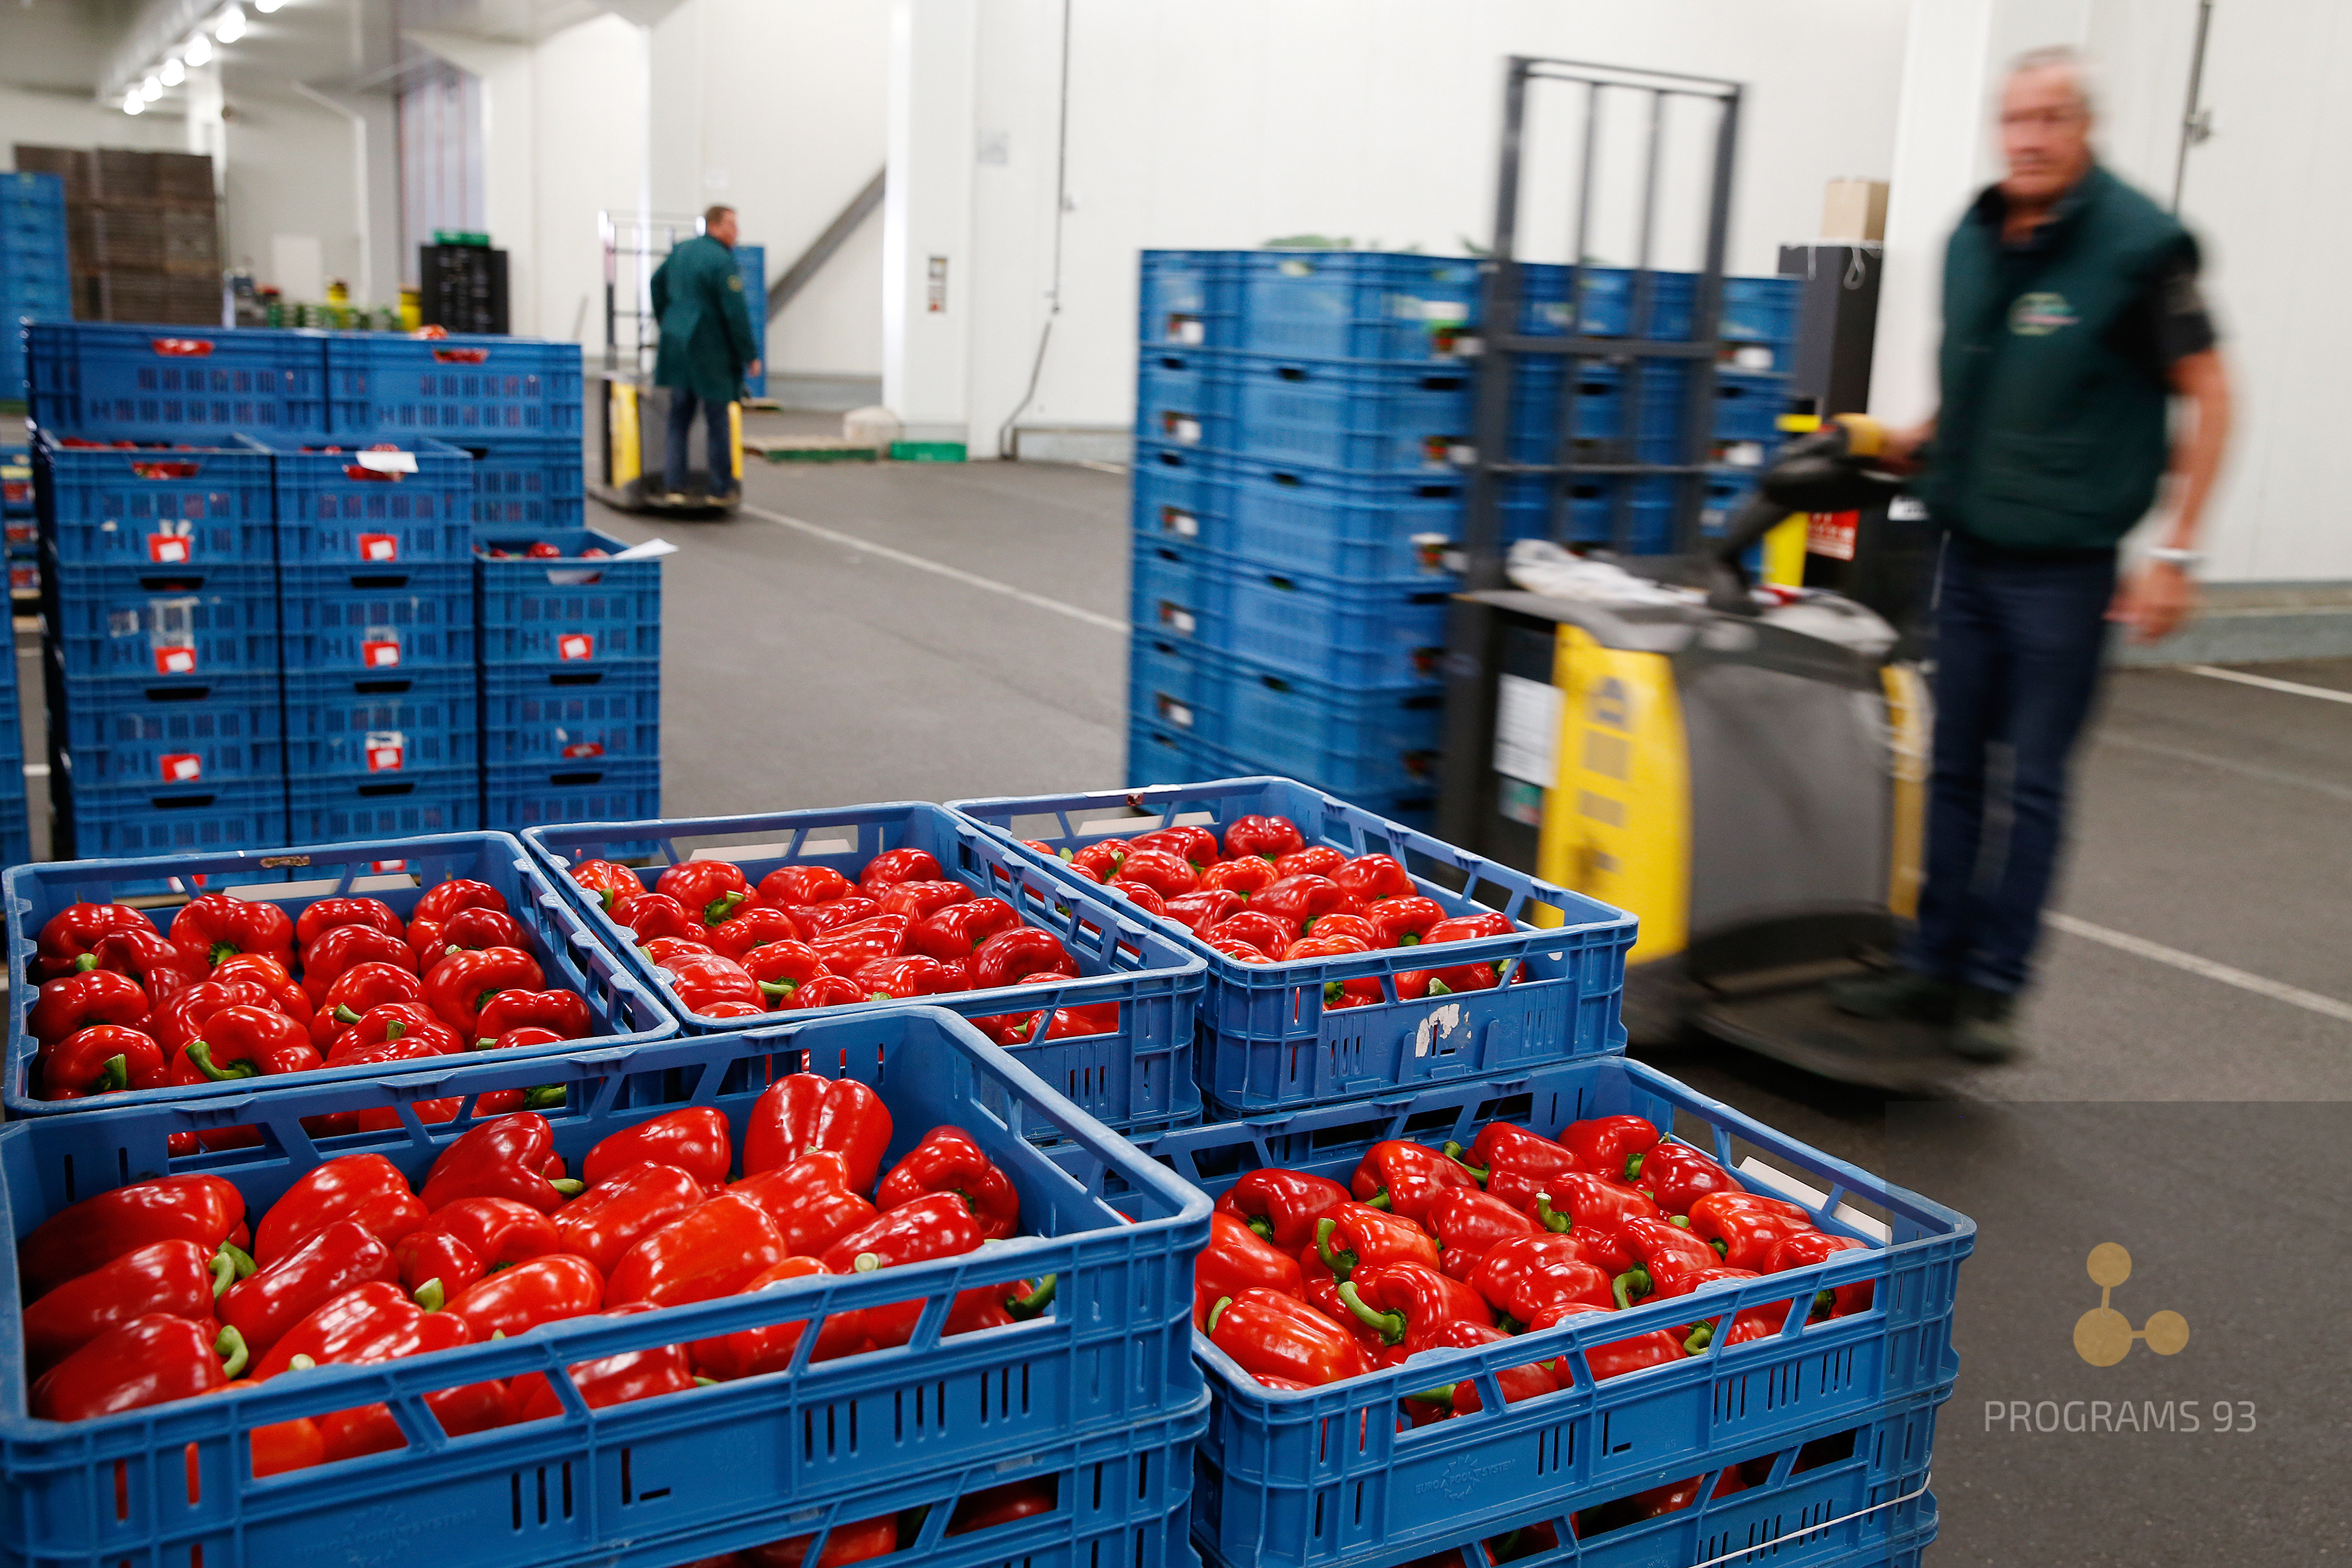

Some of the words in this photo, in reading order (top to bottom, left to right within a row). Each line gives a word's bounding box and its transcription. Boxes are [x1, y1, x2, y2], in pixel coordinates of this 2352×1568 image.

[1415, 1479, 1439, 1494] EURO
[1449, 1471, 1472, 1485] POOL
[1481, 1458, 1516, 1477] SYSTEM
